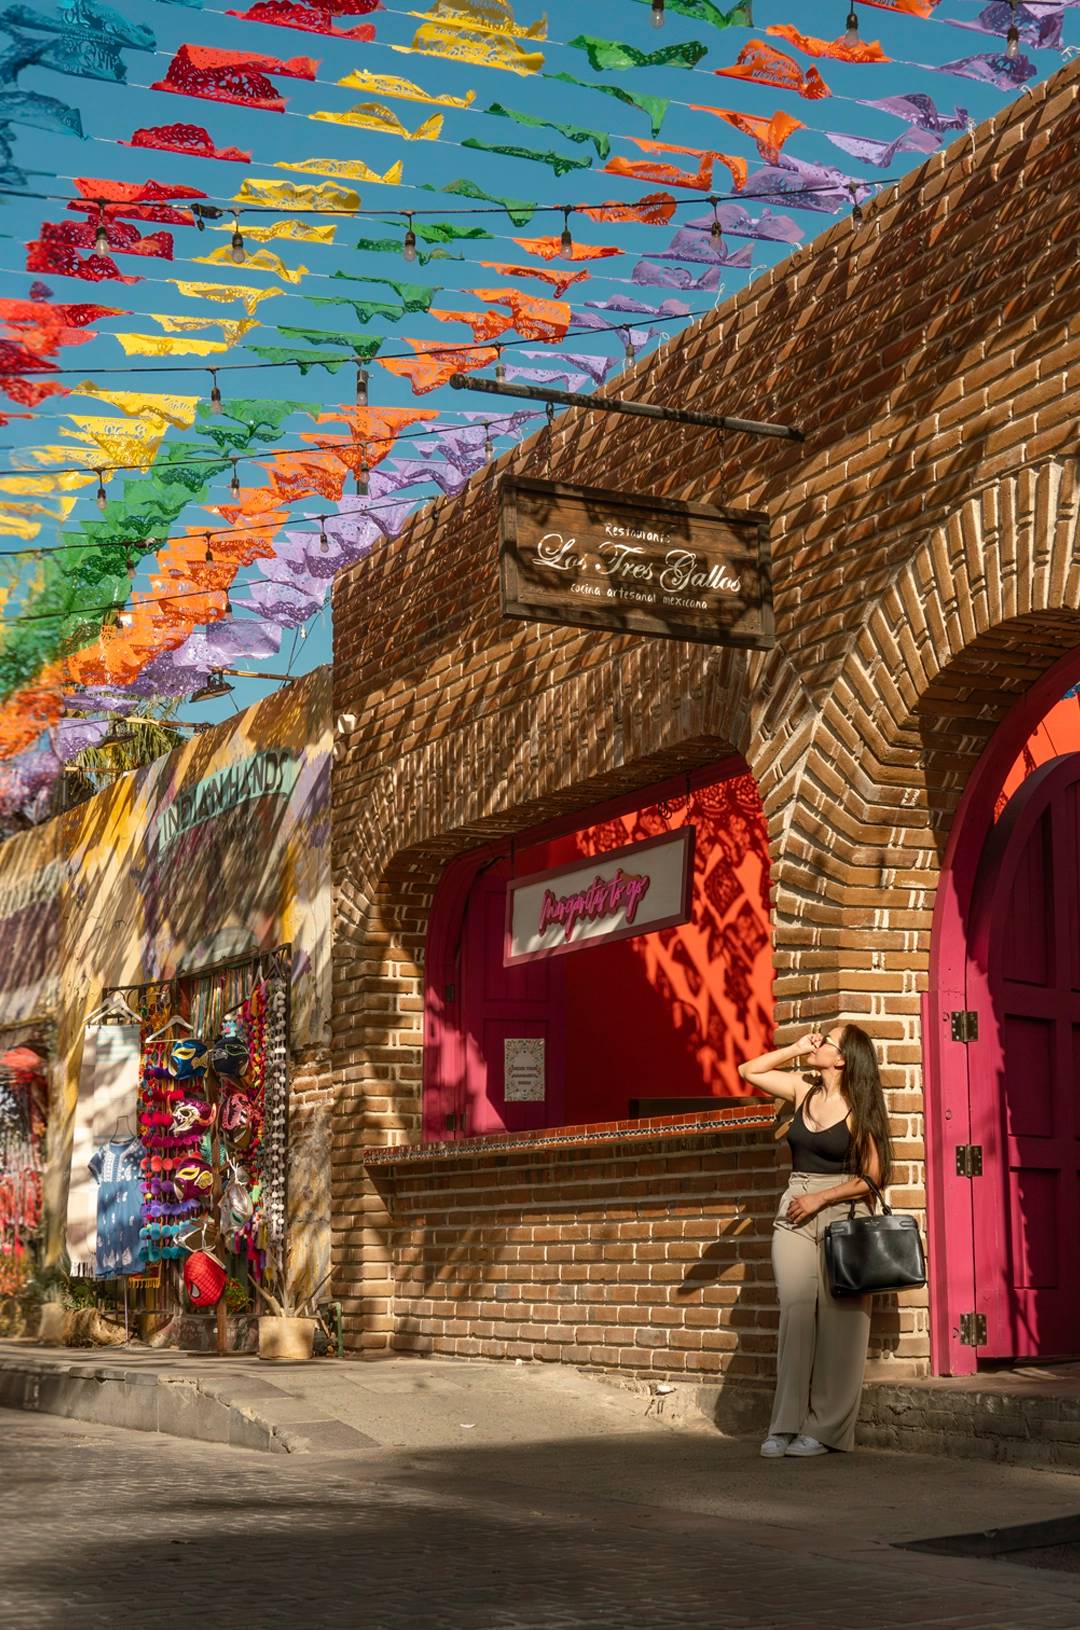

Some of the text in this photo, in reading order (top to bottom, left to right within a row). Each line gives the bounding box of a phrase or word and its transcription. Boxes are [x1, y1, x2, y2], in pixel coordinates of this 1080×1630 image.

[532, 533, 741, 593] Los Tres Gallos
[570, 583, 708, 609] cocina artesanal mexicana
[162, 751, 289, 842] INDIAN HANDS
